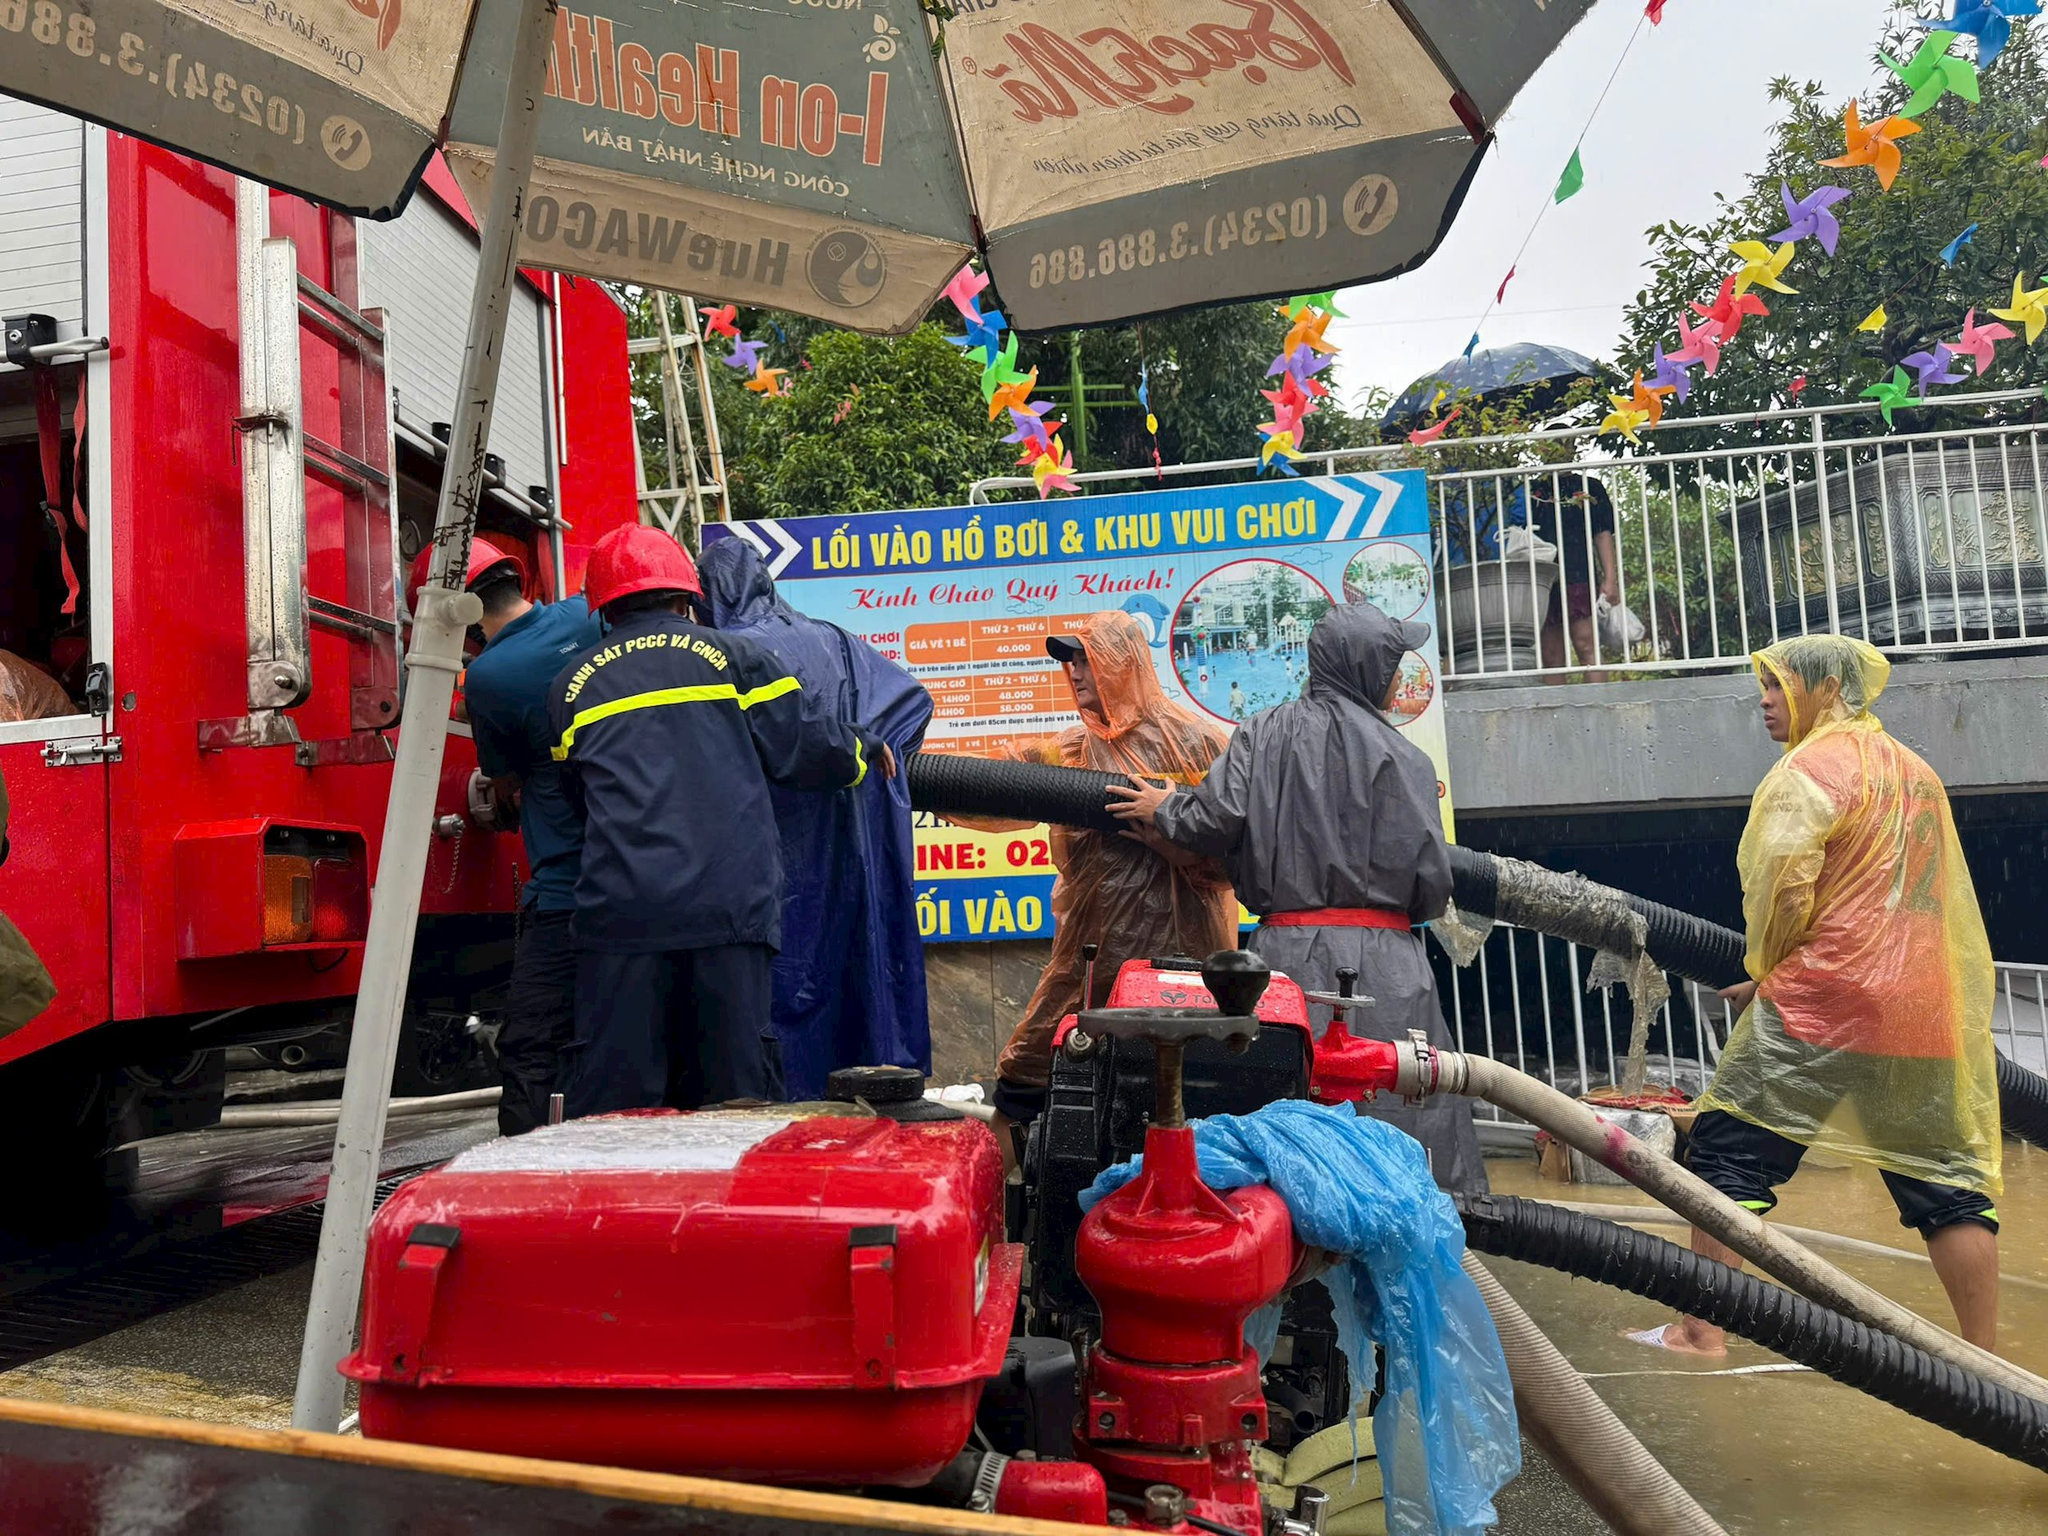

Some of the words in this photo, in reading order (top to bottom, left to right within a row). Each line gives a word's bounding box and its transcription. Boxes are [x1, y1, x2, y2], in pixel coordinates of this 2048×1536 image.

[812, 522, 861, 570] LỐI
[869, 524, 932, 566] VÀO
[945, 515, 984, 562] HỒ
[995, 519, 1048, 558] BƠI
[1060, 519, 1084, 554] &
[1095, 512, 1161, 551] KHU
[1171, 507, 1225, 544] VUI
[1237, 497, 1317, 539] CHƠI
[847, 584, 917, 610] Kính
[929, 583, 995, 604] Chào
[1005, 577, 1060, 603] Quý
[1070, 567, 1175, 595] Khách!
[981, 624, 1002, 634] THỨ
[1003, 625, 1009, 633] 2
[1016, 621, 1036, 632] THỨ
[1038, 623, 1045, 631] 6
[871, 631, 900, 644] CHƠI
[593, 643, 624, 667] SÁT
[625, 633, 667, 653] PCCC
[670, 633, 691, 650] VÀ
[909, 638, 928, 650] GIÁ
[929, 638, 944, 649] VÉ
[945, 639, 951, 648] 1
[996, 643, 1031, 653] 40.000
[984, 675, 1004, 686] THỨ
[1005, 676, 1011, 684] 2
[1019, 674, 1039, 684] THỨ
[942, 694, 970, 703] 14H00
[999, 691, 1033, 699] 48.000
[936, 707, 965, 716] 14H00
[1000, 703, 1034, 713] 58.000
[963, 890, 1043, 935] VÀO
